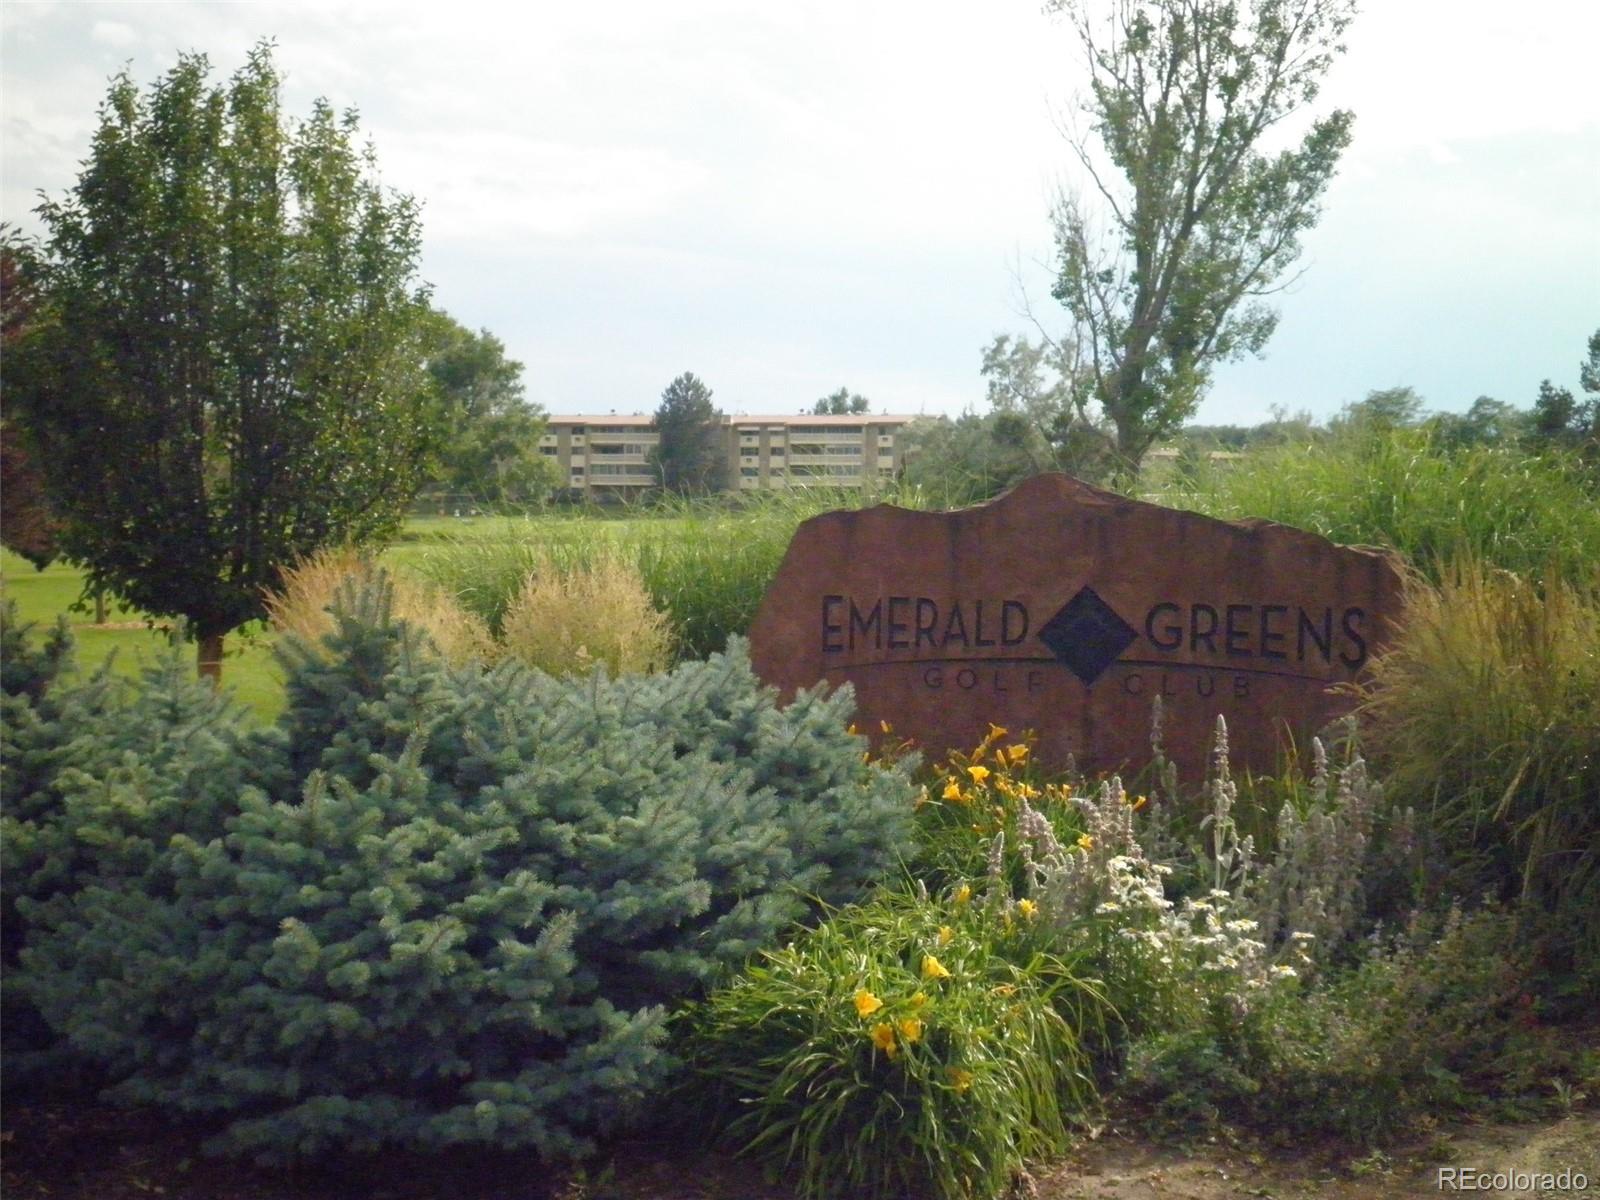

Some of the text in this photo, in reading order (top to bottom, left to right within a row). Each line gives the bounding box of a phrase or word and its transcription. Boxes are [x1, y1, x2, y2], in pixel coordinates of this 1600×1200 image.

[822, 595, 1367, 671] EMERALD GREENS
[924, 668, 1250, 697] GOLF CLUB
